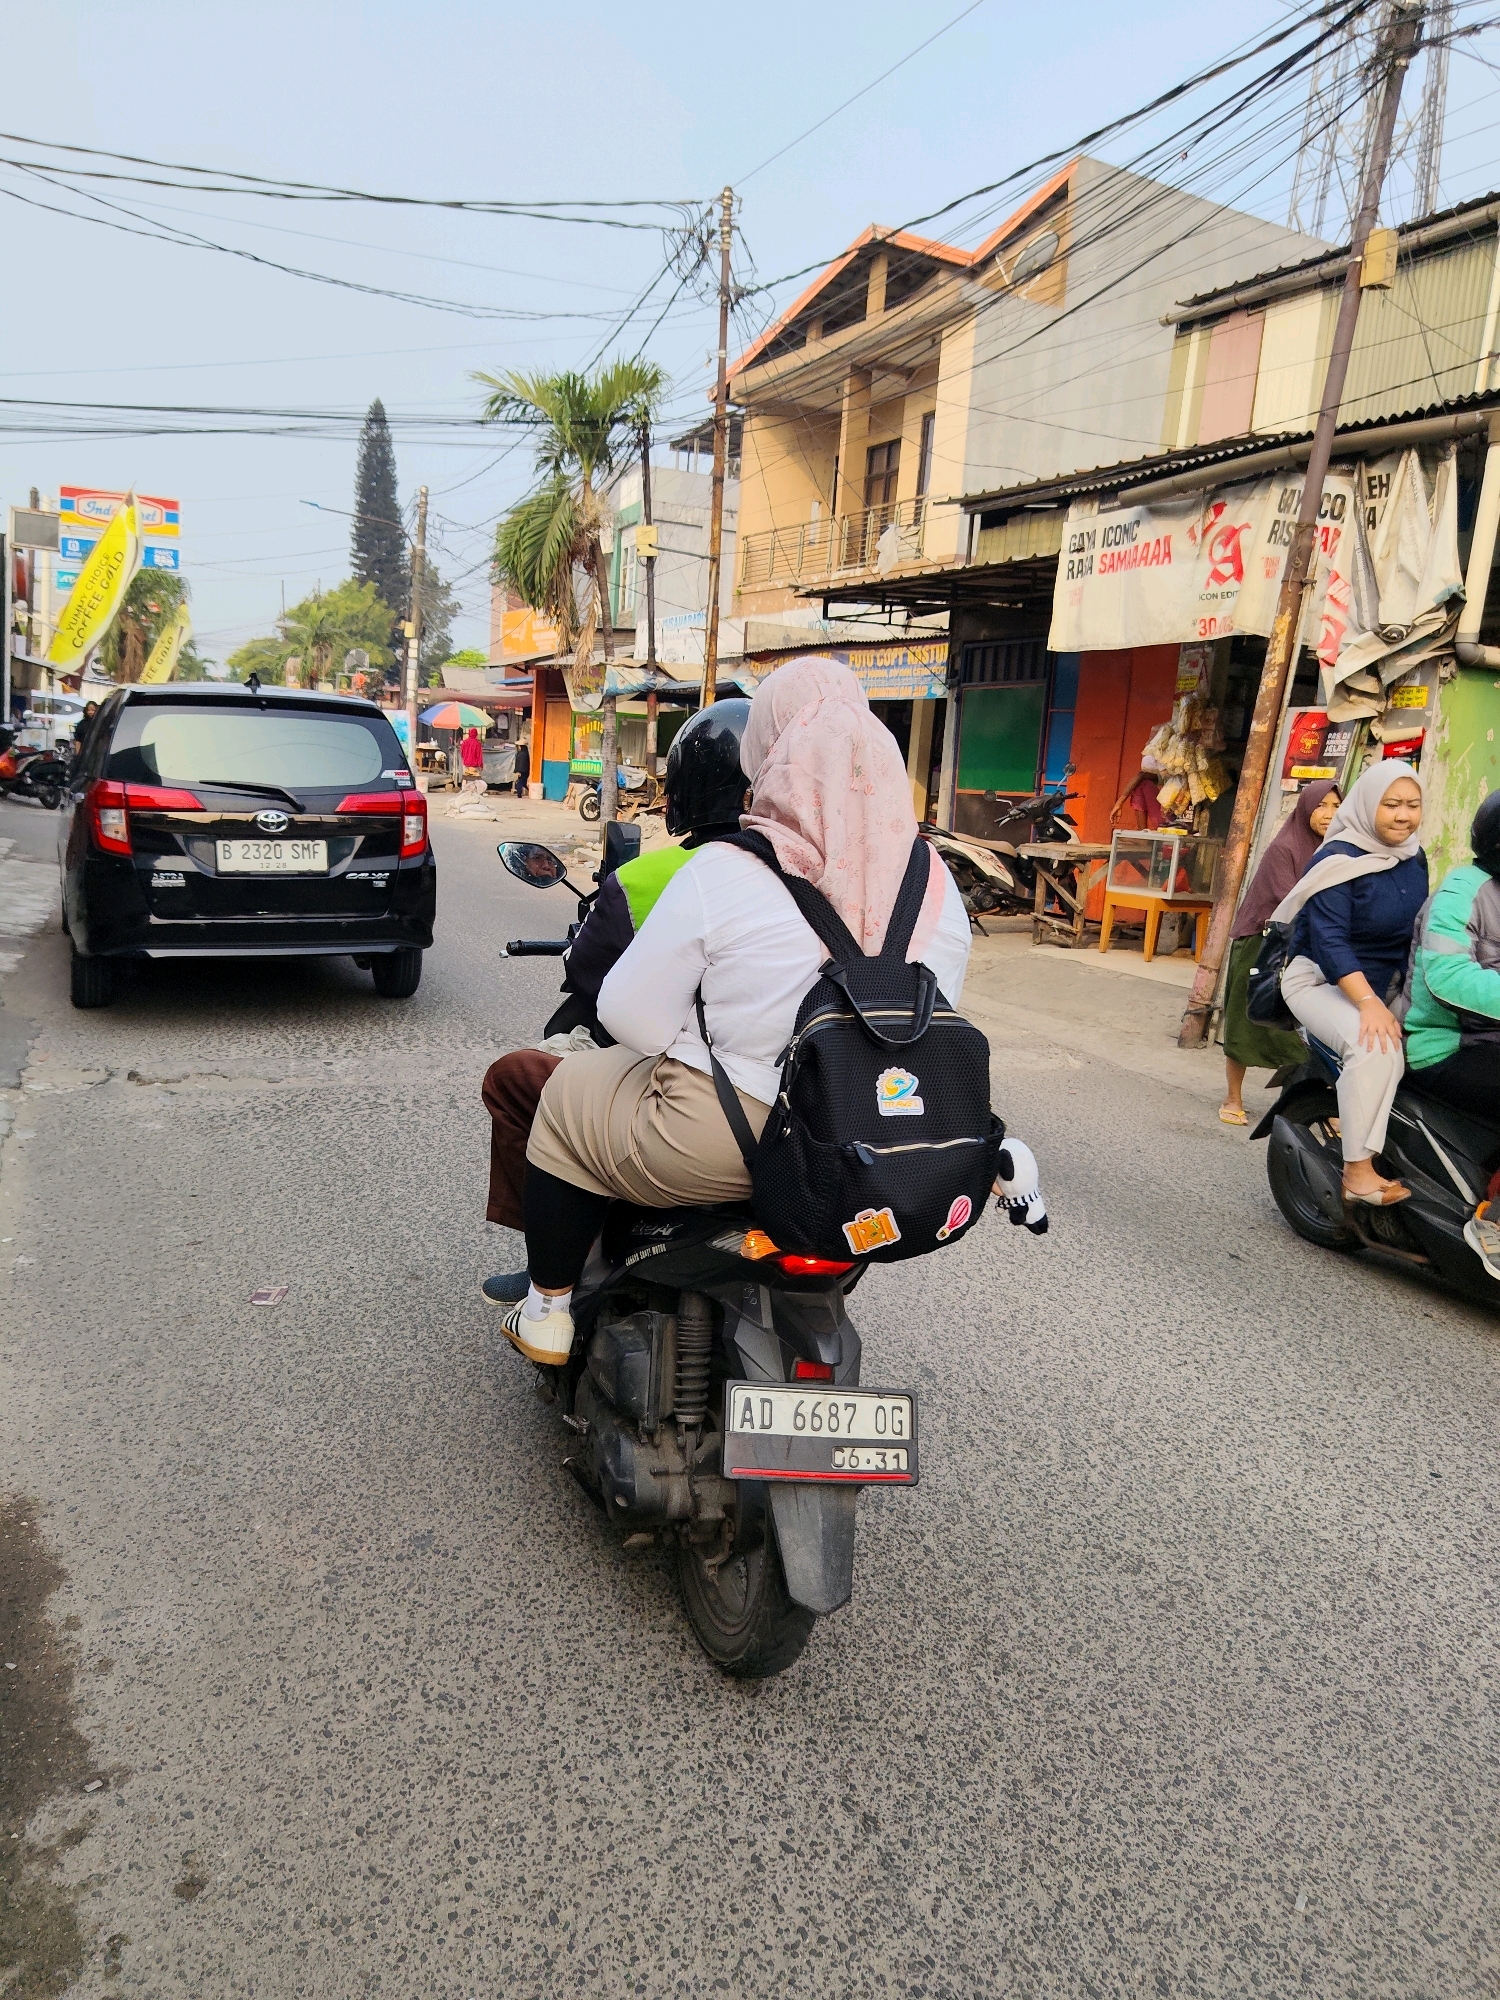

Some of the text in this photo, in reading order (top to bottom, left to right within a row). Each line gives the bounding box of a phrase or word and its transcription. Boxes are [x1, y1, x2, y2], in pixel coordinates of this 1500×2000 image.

[1366, 472, 1391, 500] EH
[1101, 519, 1141, 549] ICONIC
[85, 552, 110, 591] CHOICE
[72, 591, 105, 649] COFFEE
[100, 551, 125, 590] GOLD
[1198, 590, 1239, 602] ICON EDIT
[849, 650, 874, 668] FOTO
[876, 647, 906, 666] COPY
[222, 843, 321, 860] B 2320 SMF
[883, 1100, 920, 1108] TRAVEL
[739, 1396, 773, 1430] AD
[792, 1399, 857, 1434] 6687
